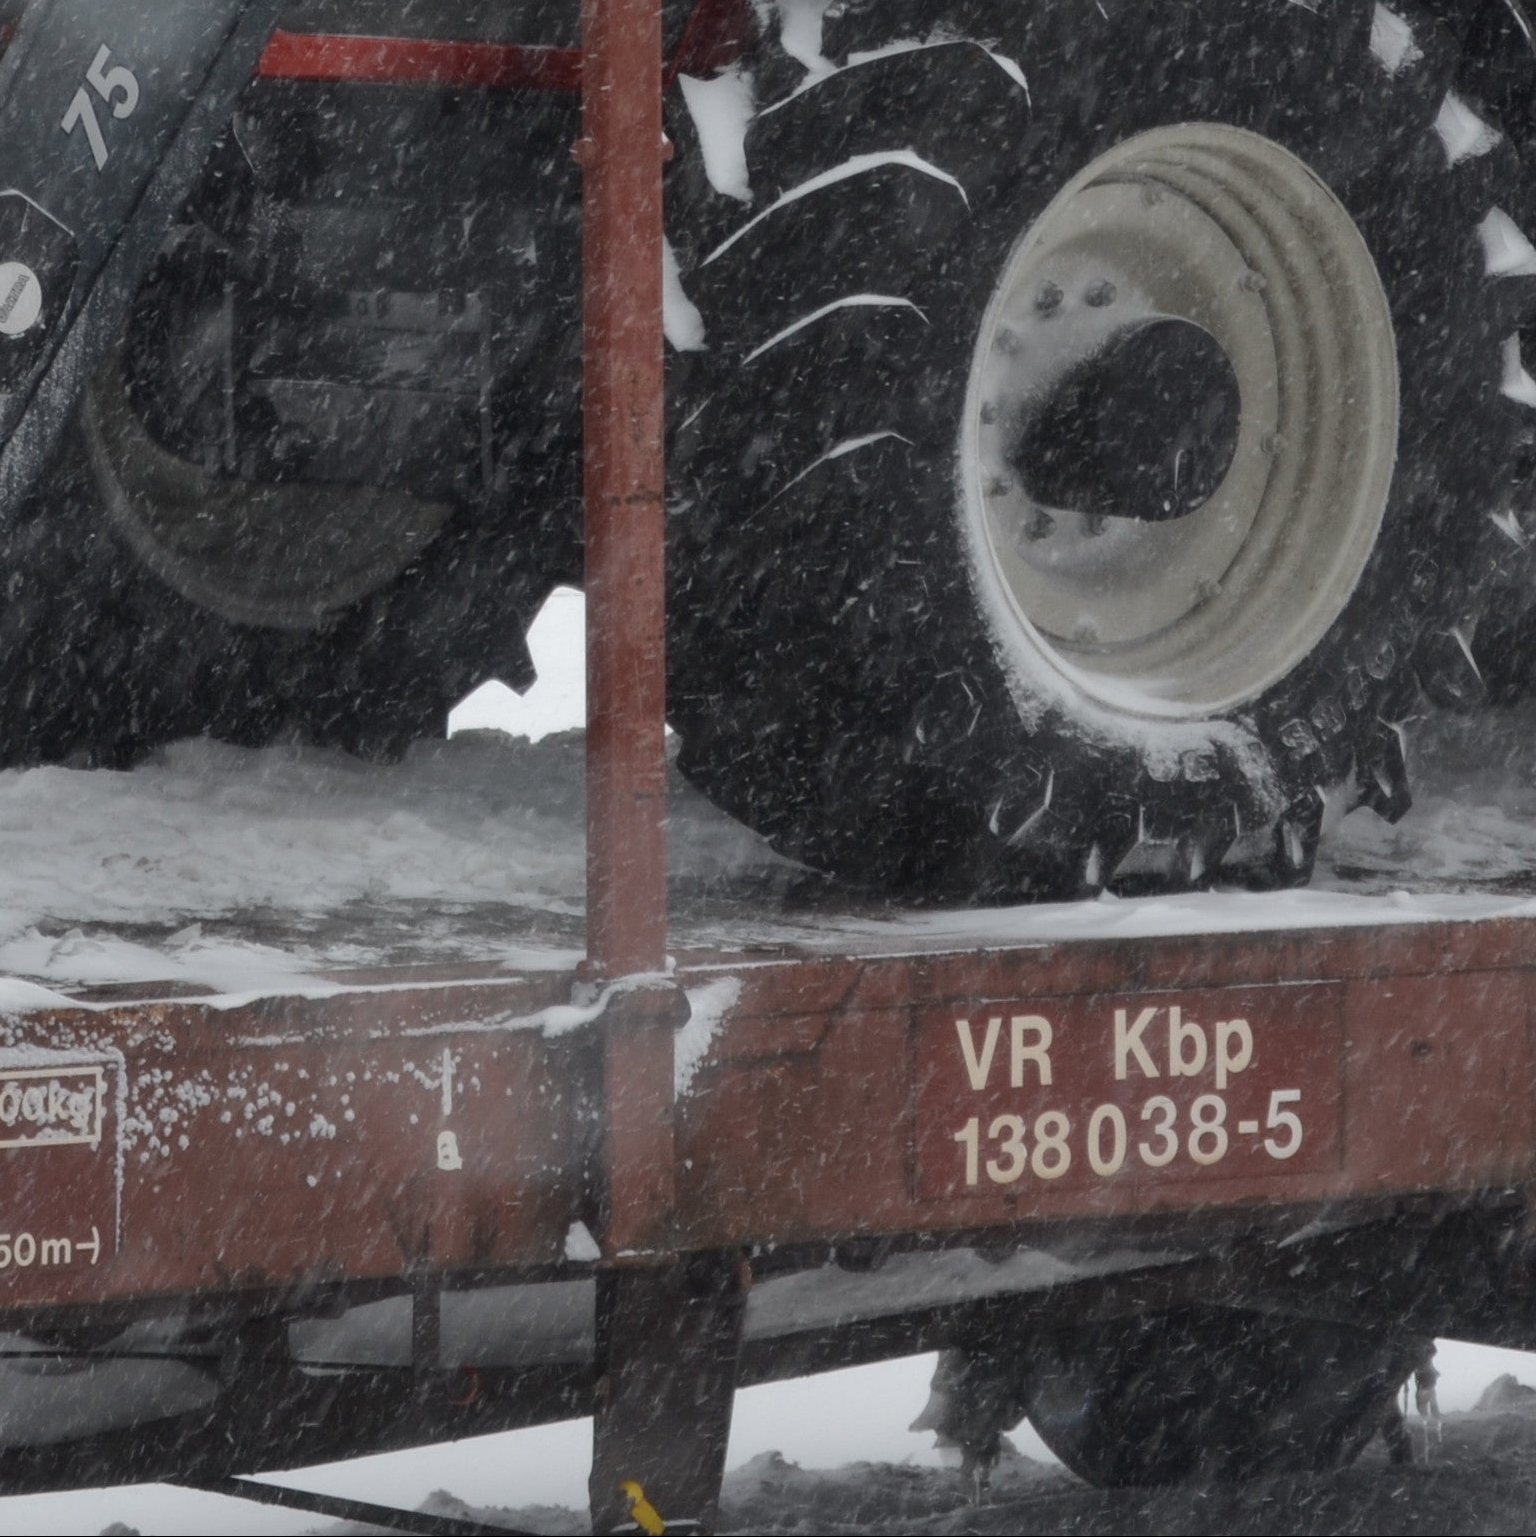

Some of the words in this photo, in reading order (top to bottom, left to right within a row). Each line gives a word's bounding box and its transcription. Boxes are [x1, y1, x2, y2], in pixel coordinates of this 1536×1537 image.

[60, 43, 140, 172] 75
[955, 1015, 1053, 1091] VR
[1113, 1005, 1254, 1090] Kbp
